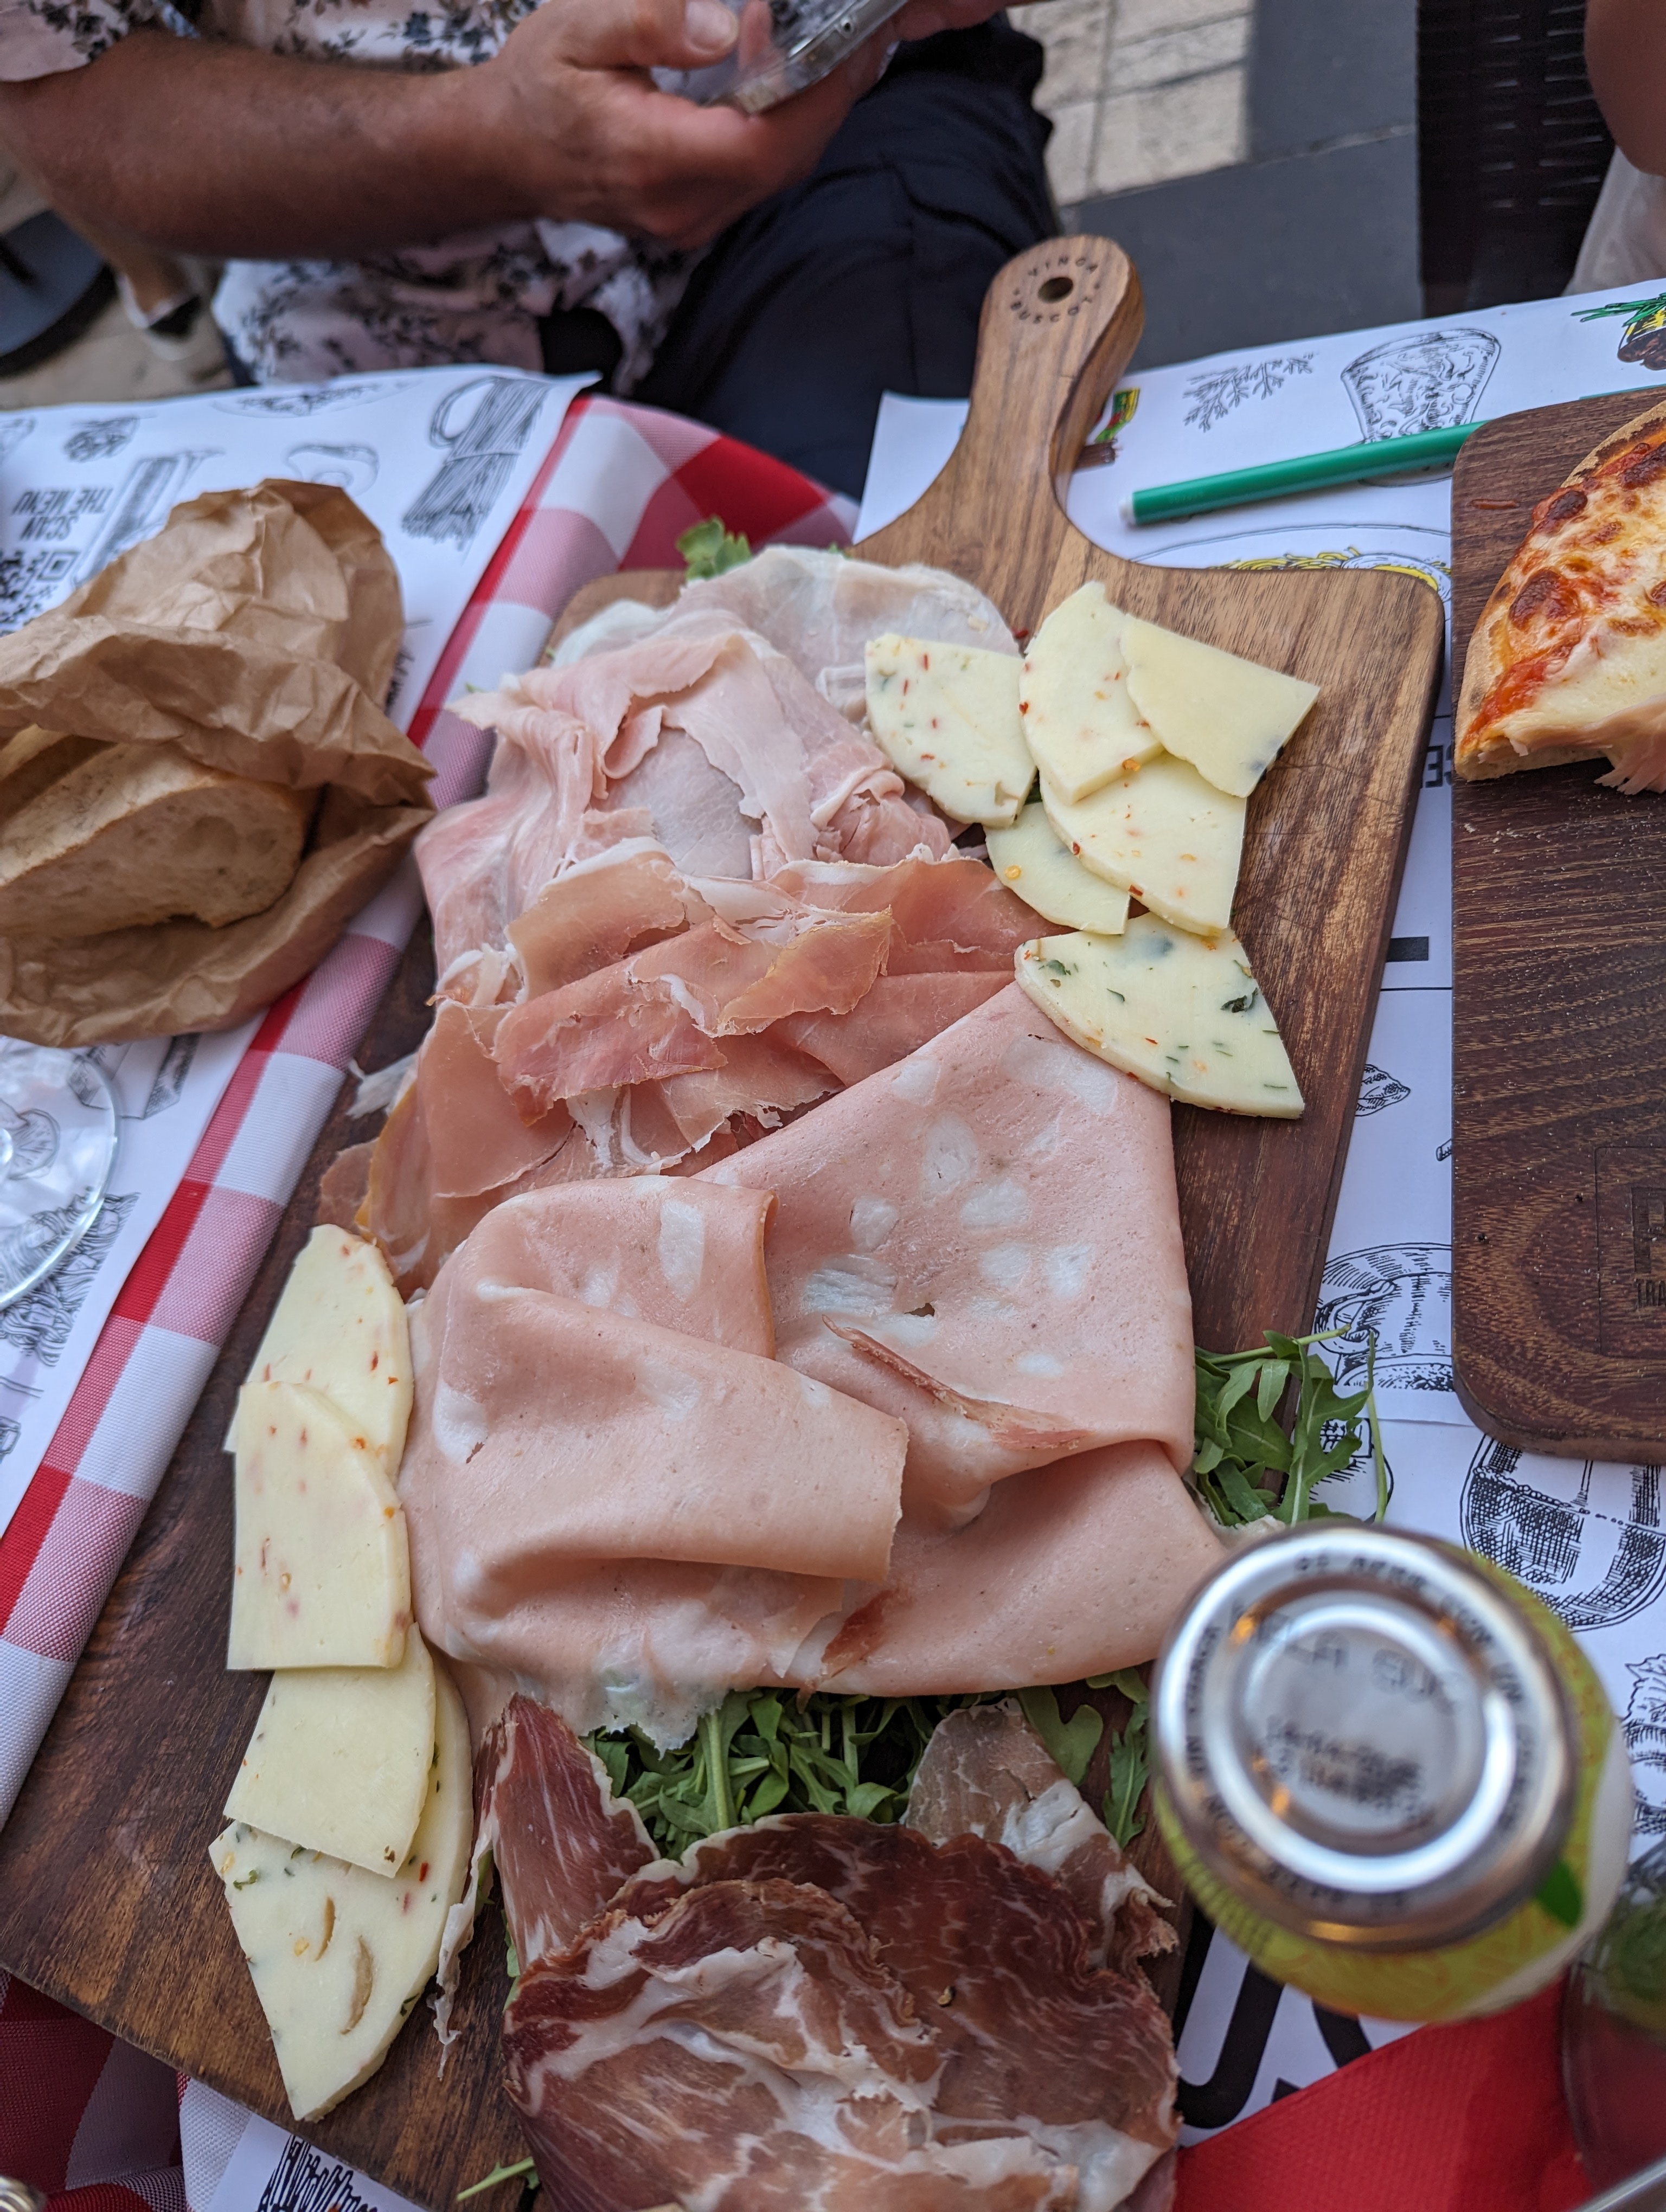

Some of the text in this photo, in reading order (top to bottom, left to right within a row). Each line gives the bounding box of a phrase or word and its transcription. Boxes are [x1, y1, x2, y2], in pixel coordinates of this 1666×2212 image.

[12, 487, 113, 515] THE MENU
[20, 515, 79, 541] SCAN
